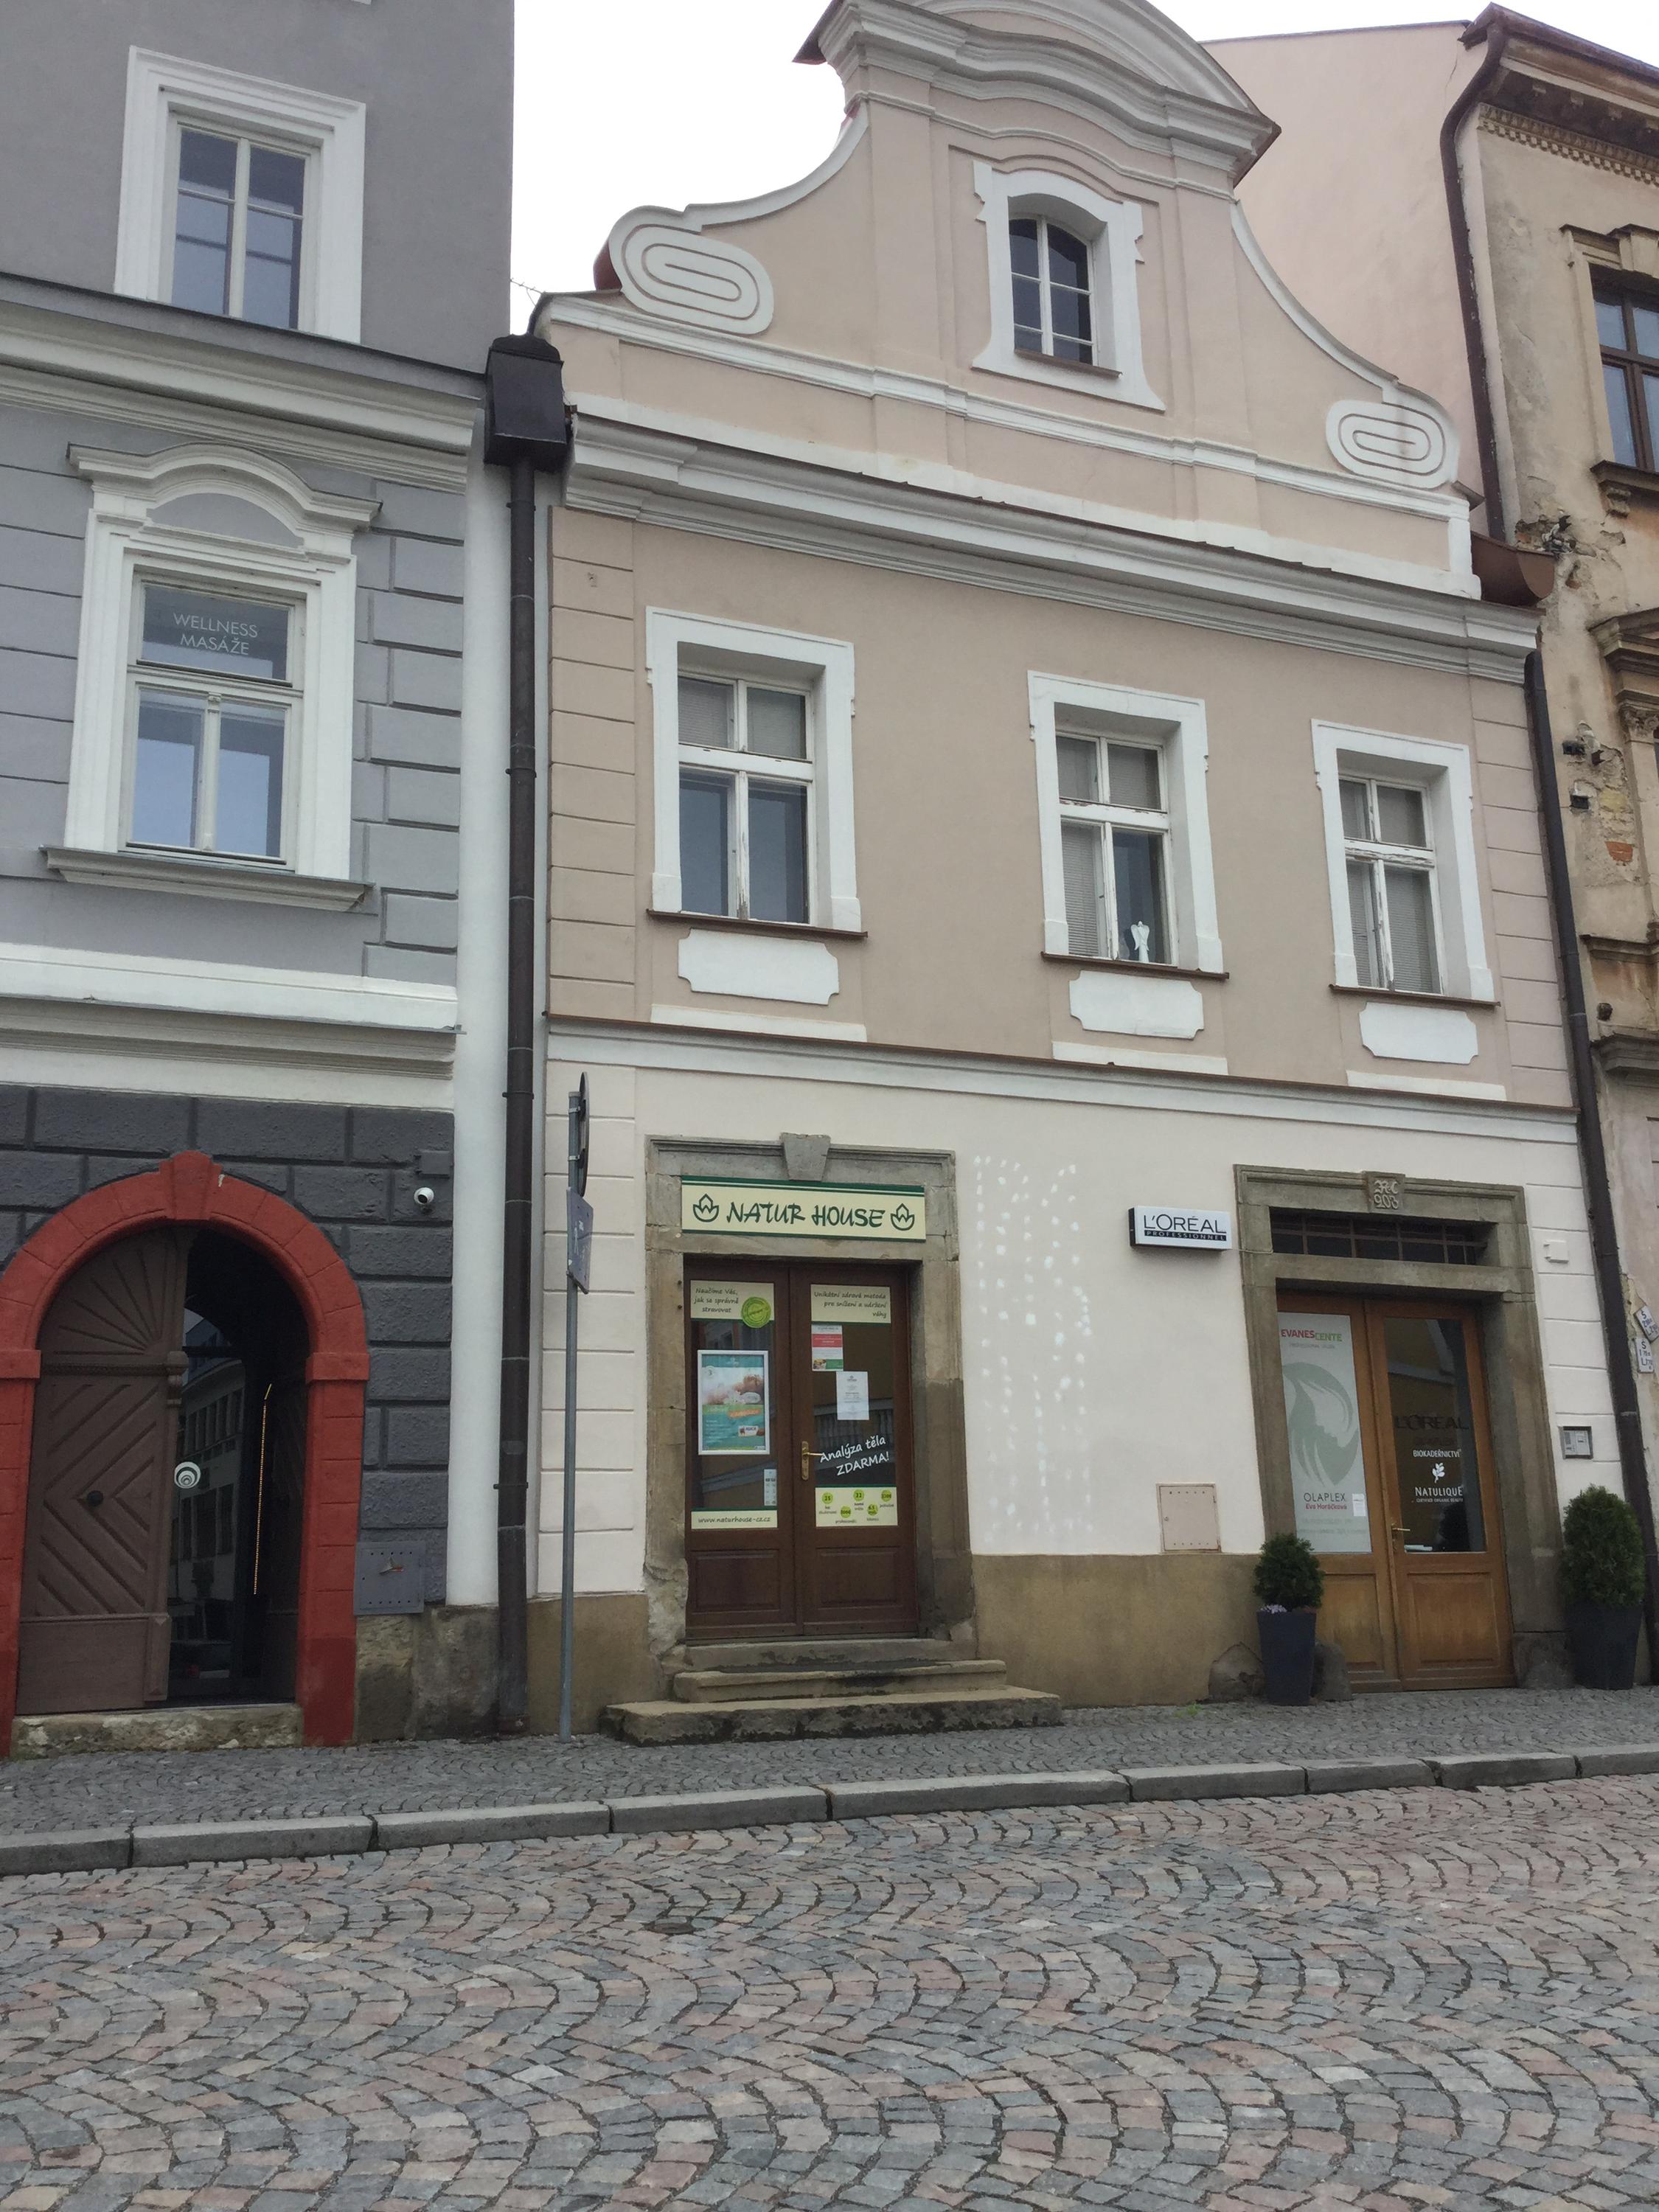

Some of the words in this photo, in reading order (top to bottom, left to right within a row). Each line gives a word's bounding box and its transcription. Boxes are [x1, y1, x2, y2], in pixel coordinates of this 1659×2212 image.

[173, 612, 258, 638] WELLNESS
[180, 633, 249, 655] MASÁŽE
[726, 1201, 806, 1225] NATUR
[811, 1204, 886, 1228] HOUSE
[1144, 1214, 1227, 1234] L'ORÉAL
[1146, 1231, 1225, 1241] PROFESSIONNEL
[1281, 1329, 1343, 1342] EVANESCENTE
[820, 1443, 863, 1463] Analýza
[865, 1435, 886, 1450] těla
[836, 1450, 889, 1476] ZDARMA!
[1303, 1492, 1346, 1502] OLAPLEX
